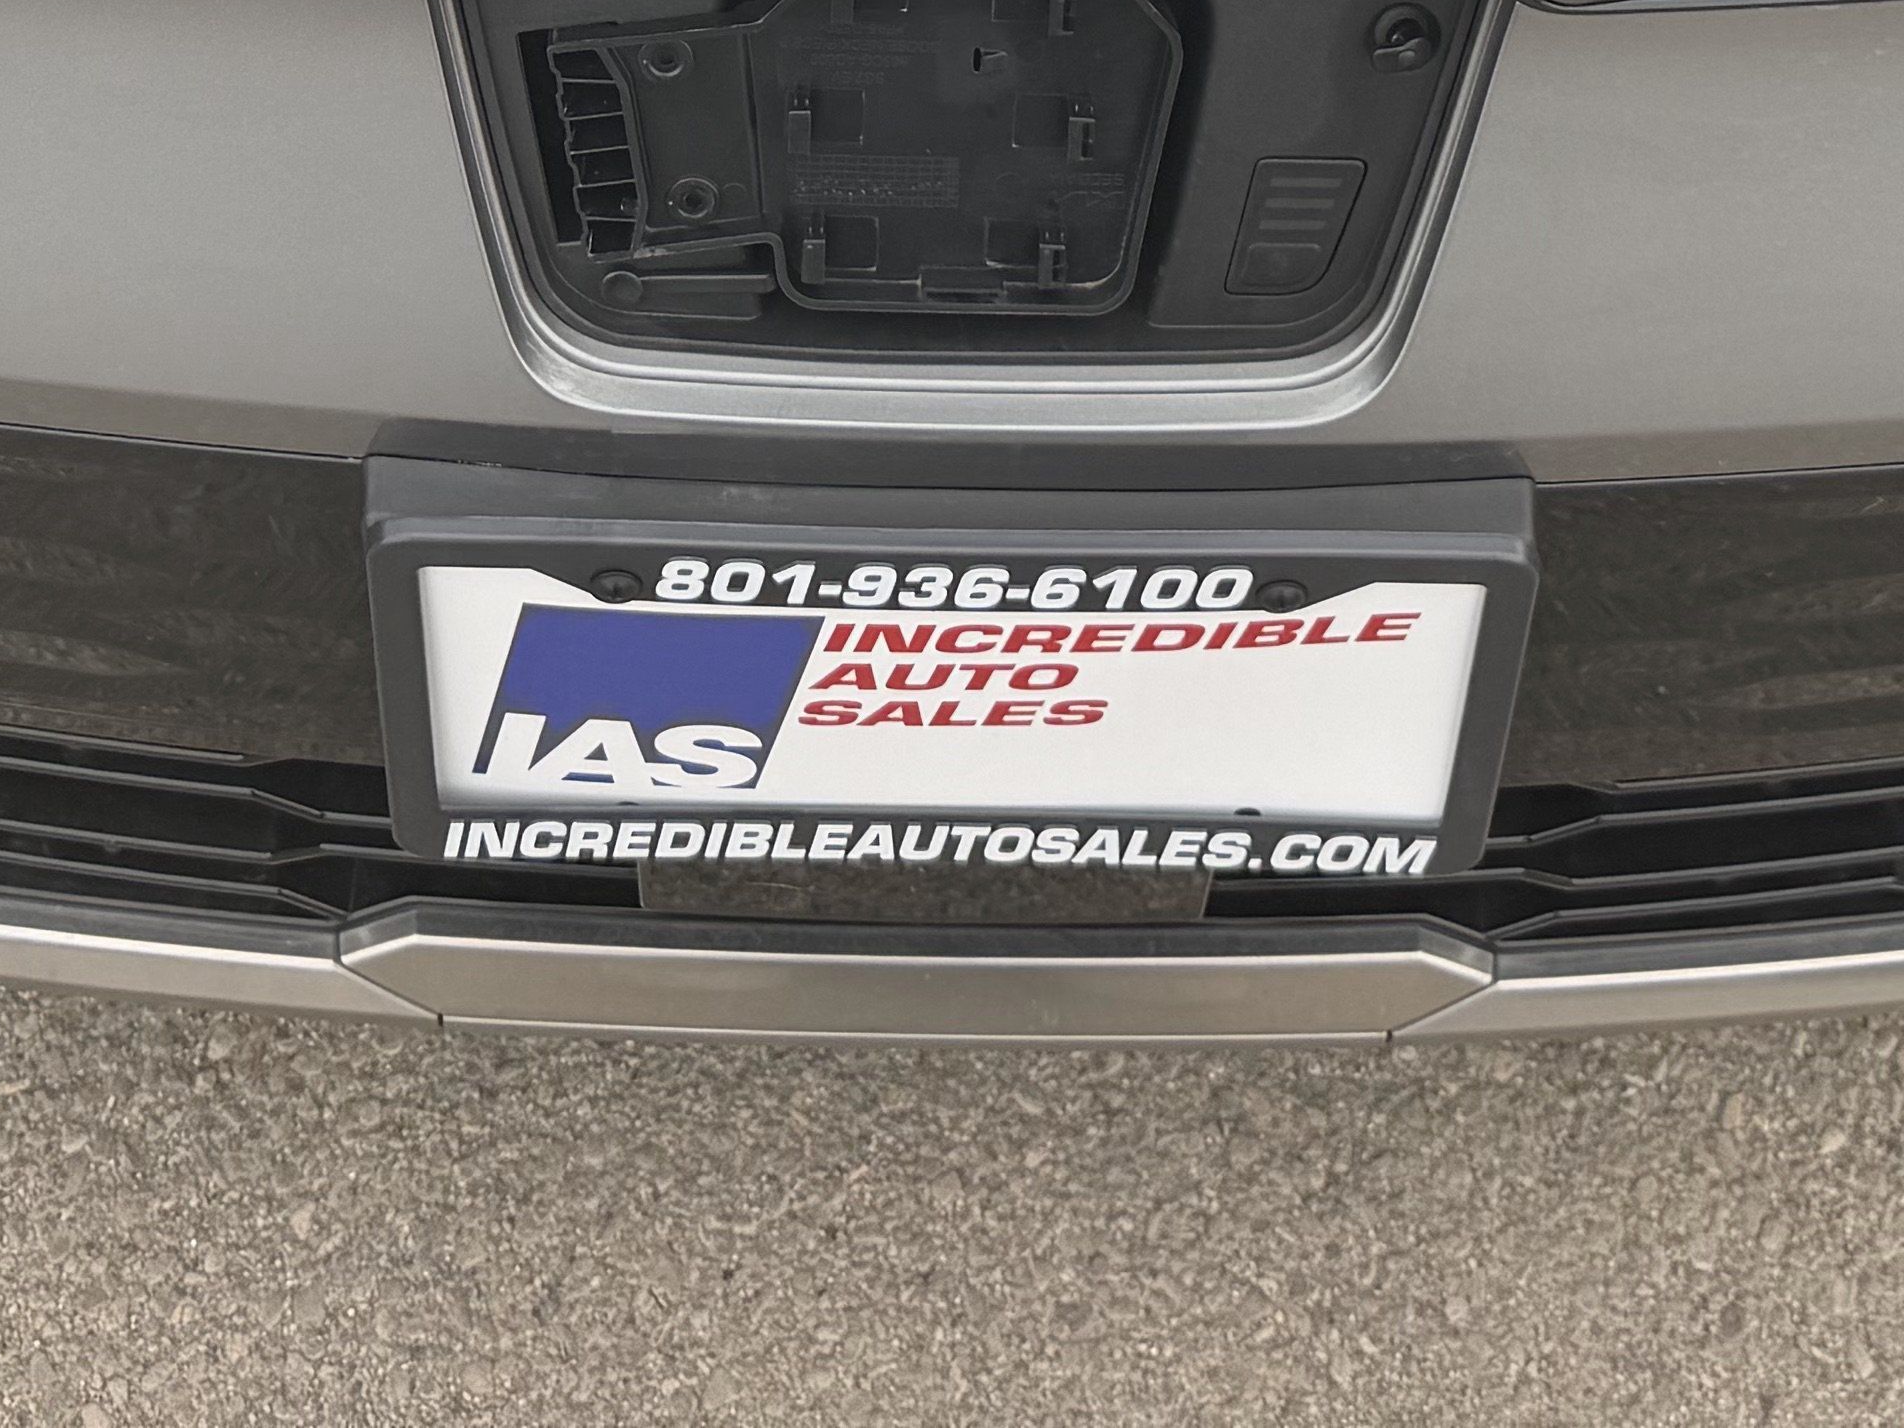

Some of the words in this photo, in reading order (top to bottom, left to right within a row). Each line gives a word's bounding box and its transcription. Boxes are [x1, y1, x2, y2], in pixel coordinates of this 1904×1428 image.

[653, 558, 1256, 613] 801-936-6100
[821, 612, 1421, 655] INCREDIBLE
[810, 662, 1079, 692] AUTO
[797, 698, 1110, 729] SALES
[470, 712, 764, 791] IAS
[443, 819, 1439, 877] INCREDIBLEAUTOSALES.COM
